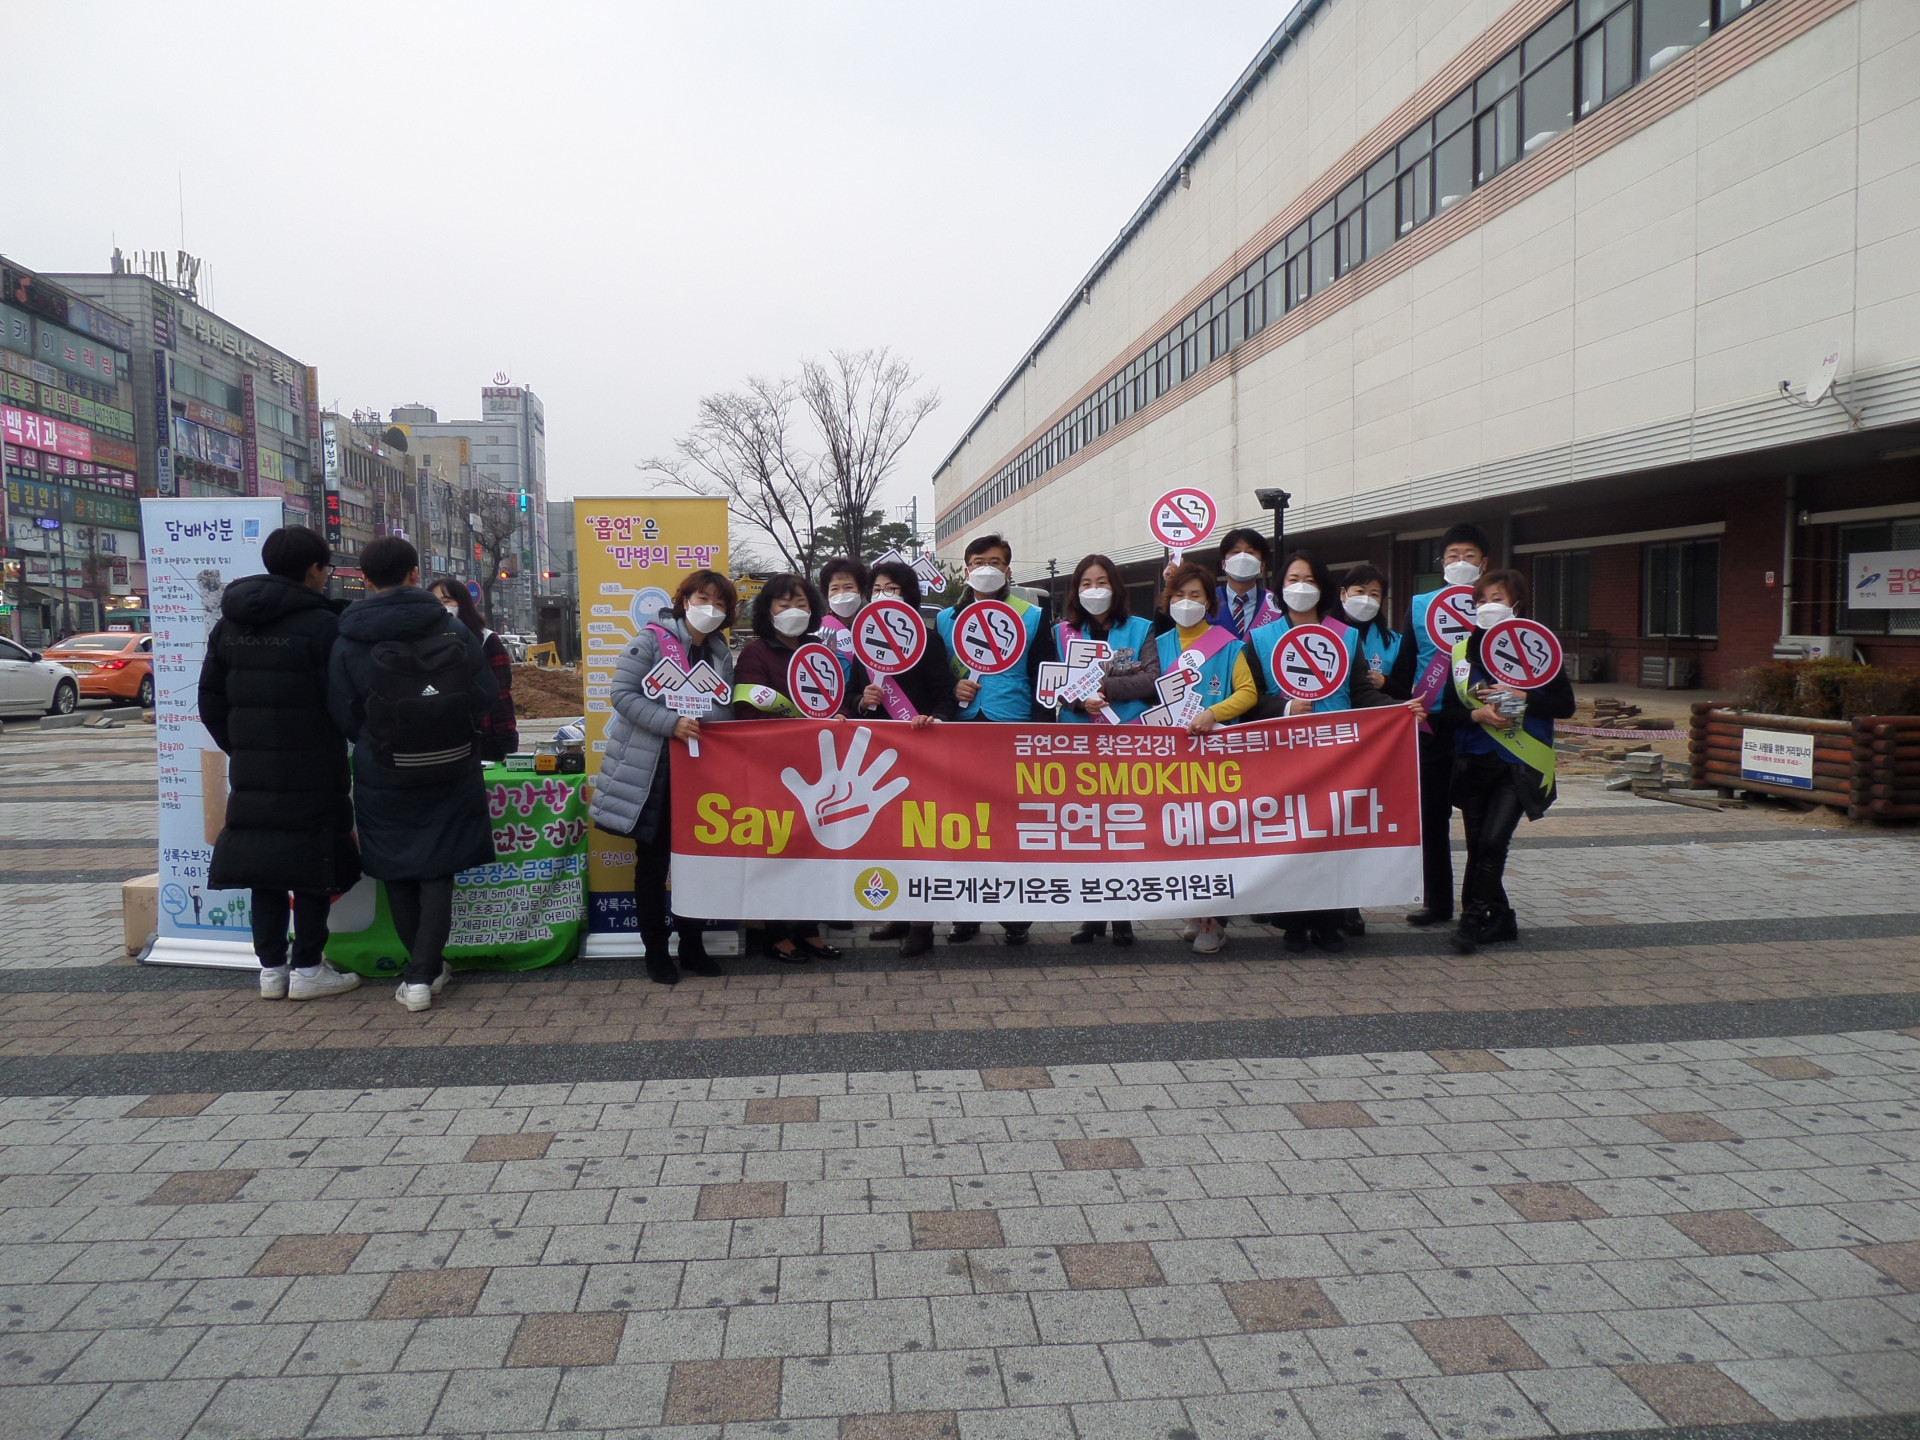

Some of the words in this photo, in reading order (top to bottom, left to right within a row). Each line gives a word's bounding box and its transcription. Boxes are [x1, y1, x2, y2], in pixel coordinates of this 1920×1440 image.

[482, 387, 522, 400] 사우나
[1161, 510, 1170, 519] 금
[164, 518, 234, 542] 담배성분
[1173, 529, 1182, 538] 연
[1438, 615, 1448, 626] 금
[866, 624, 875, 635] 금
[968, 622, 978, 633] 금
[1497, 637, 1508, 648] 금
[875, 649, 885, 660] 연
[974, 648, 984, 659] 연
[1286, 651, 1296, 662] 금
[1503, 662, 1514, 673] 연
[799, 671, 807, 682] 금
[1298, 676, 1308, 687] 연
[811, 696, 818, 707] 연
[1014, 734, 1090, 756] 금연으로
[1096, 734, 1177, 756] 찾은건강!
[1187, 731, 1269, 755] 가족튼튼!
[1275, 722, 1360, 748] 나라튼튼!
[1016, 761, 1066, 796] NO
[1076, 760, 1242, 796] SMOKING
[694, 793, 795, 855] Say
[902, 800, 991, 850] No!
[1016, 801, 1148, 851] 금연은
[1161, 787, 1399, 847] 예의입니다.
[493, 825, 538, 852] 없는
[601, 852, 635, 867] 당신의
[171, 866, 181, 877] T.
[522, 854, 578, 880] 금연구역
[468, 886, 488, 901] 경계
[552, 878, 582, 893] 승차대
[908, 876, 1071, 904] 바르게살기운동
[1079, 872, 1235, 903] 본오3동위원회
[461, 917, 502, 931] 제곱미터
[544, 909, 575, 922] 어린이
[608, 917, 620, 928] T.
[452, 929, 495, 945] 과태료가
